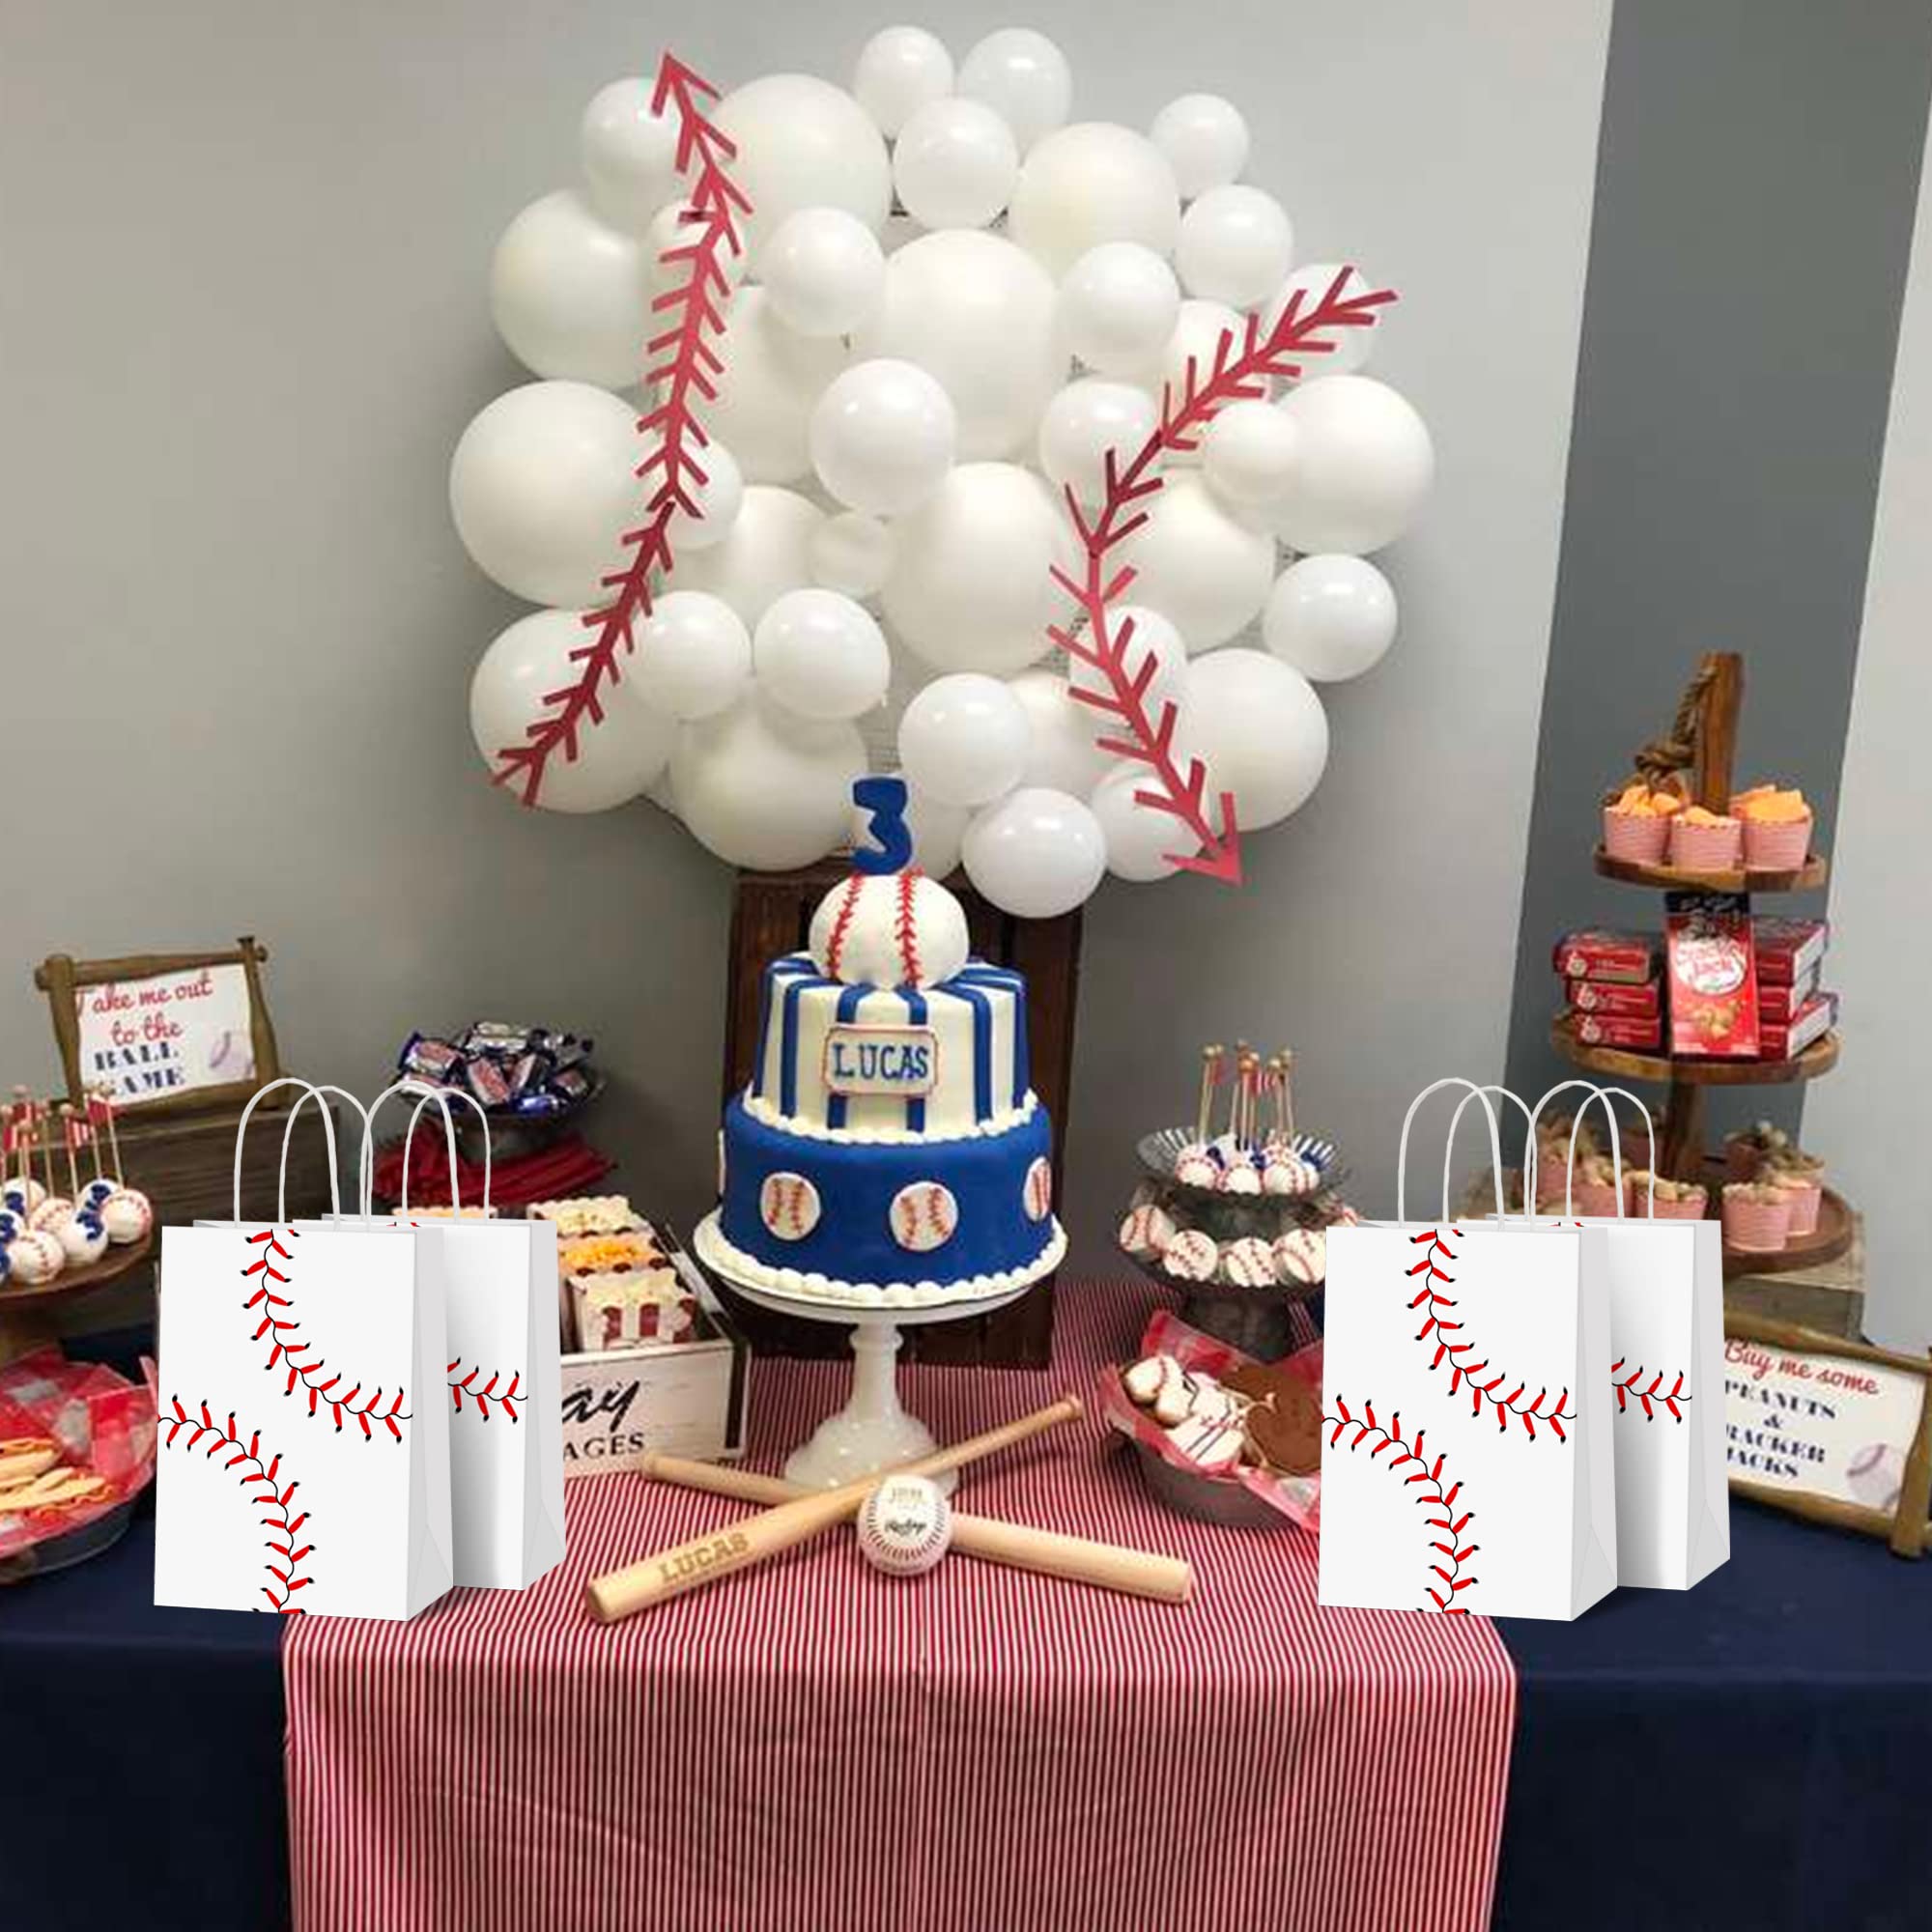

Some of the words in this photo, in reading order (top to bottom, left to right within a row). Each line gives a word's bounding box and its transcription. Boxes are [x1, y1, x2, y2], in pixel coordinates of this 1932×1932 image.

[853, 777, 913, 875] 3
[139, 987, 172, 1006] me
[175, 969, 213, 1000] out
[110, 1020, 137, 1046] to
[143, 1010, 184, 1040] the
[94, 1041, 181, 1071] BALL
[832, 1042, 929, 1080] LUCAS
[1725, 1340, 1772, 1380] Buy
[1778, 1359, 1813, 1378] me
[1816, 1369, 1880, 1395] some
[1725, 1379, 1836, 1420] PEANUTS
[1763, 1413, 1784, 1430] &
[563, 1432, 645, 1462] AGES
[1725, 1424, 1825, 1463] RACKER
[659, 1532, 749, 1582] LUCAS
